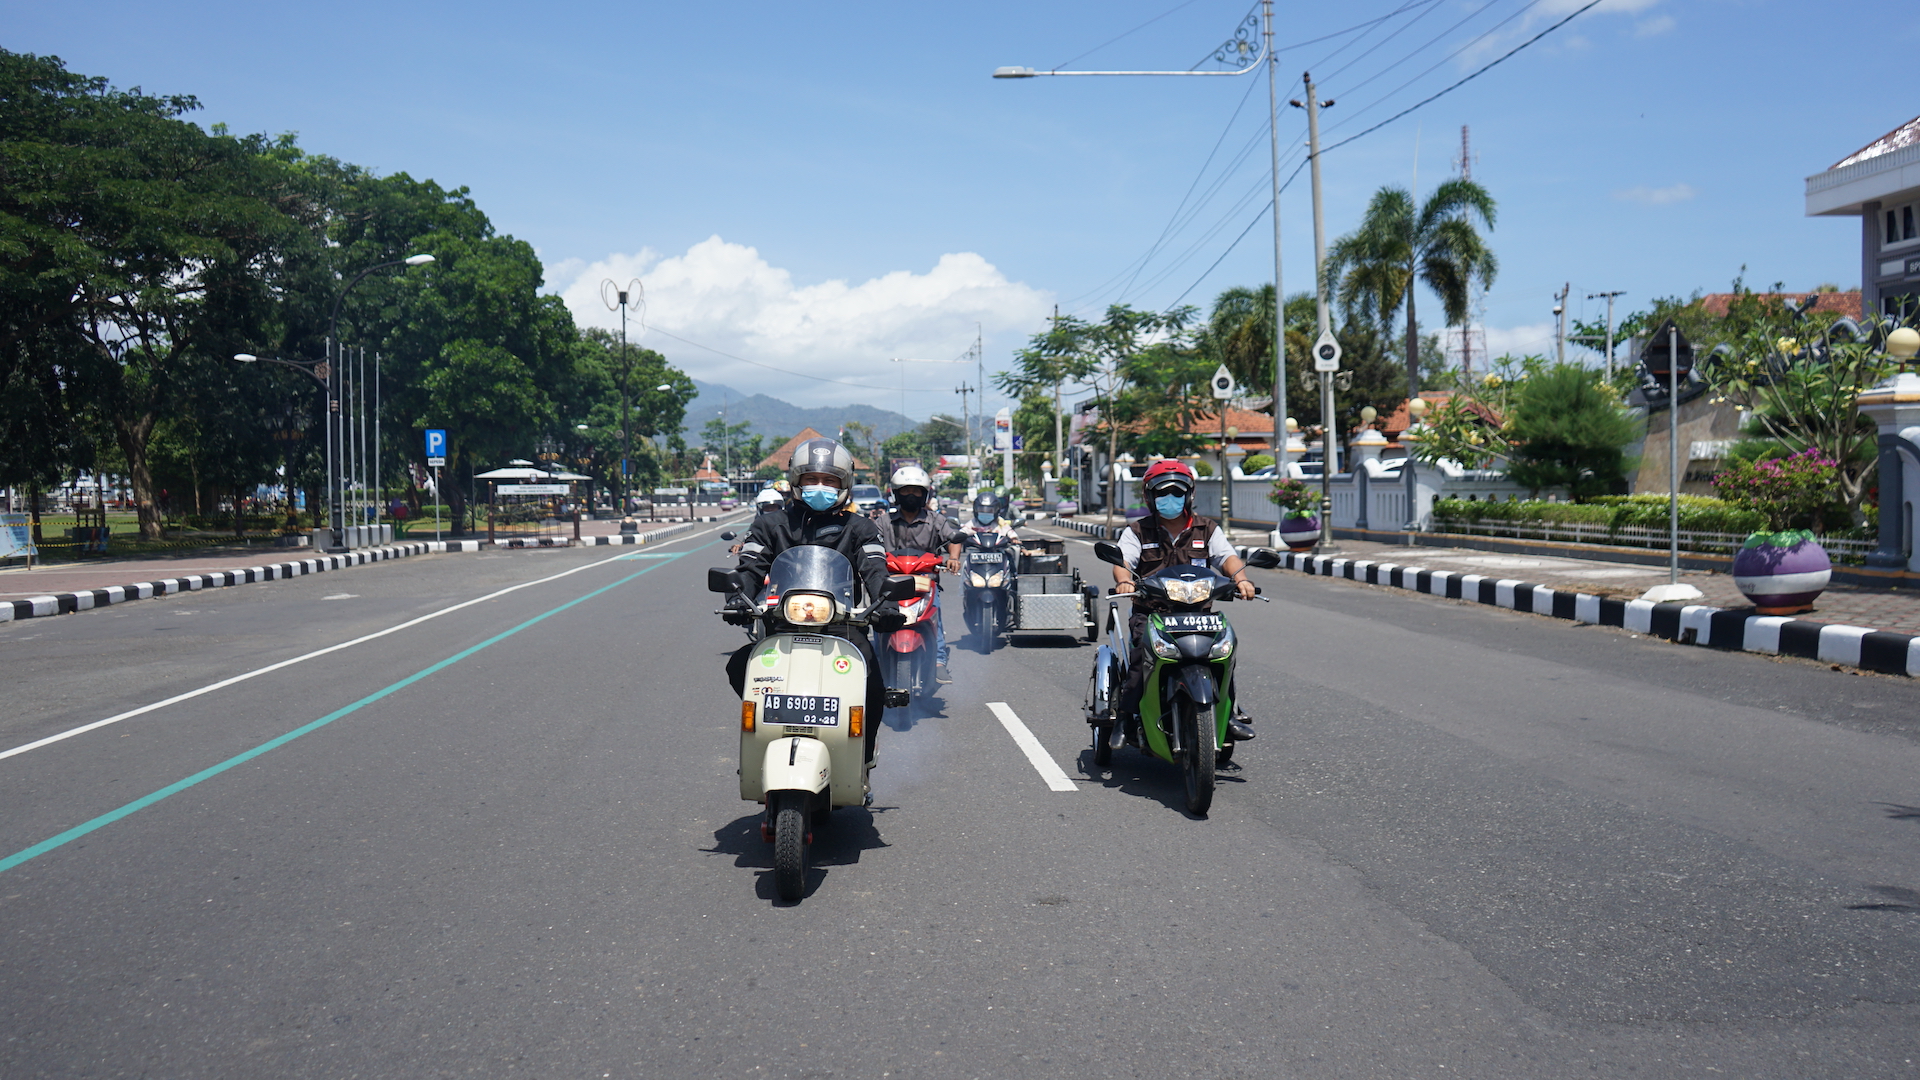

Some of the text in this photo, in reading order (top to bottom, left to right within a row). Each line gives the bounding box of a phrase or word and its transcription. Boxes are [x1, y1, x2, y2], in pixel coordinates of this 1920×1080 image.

[429, 432, 442, 453] P
[1165, 617, 1178, 627] AA
[1210, 615, 1222, 625] VL
[765, 696, 838, 711] AB 6908 EB
